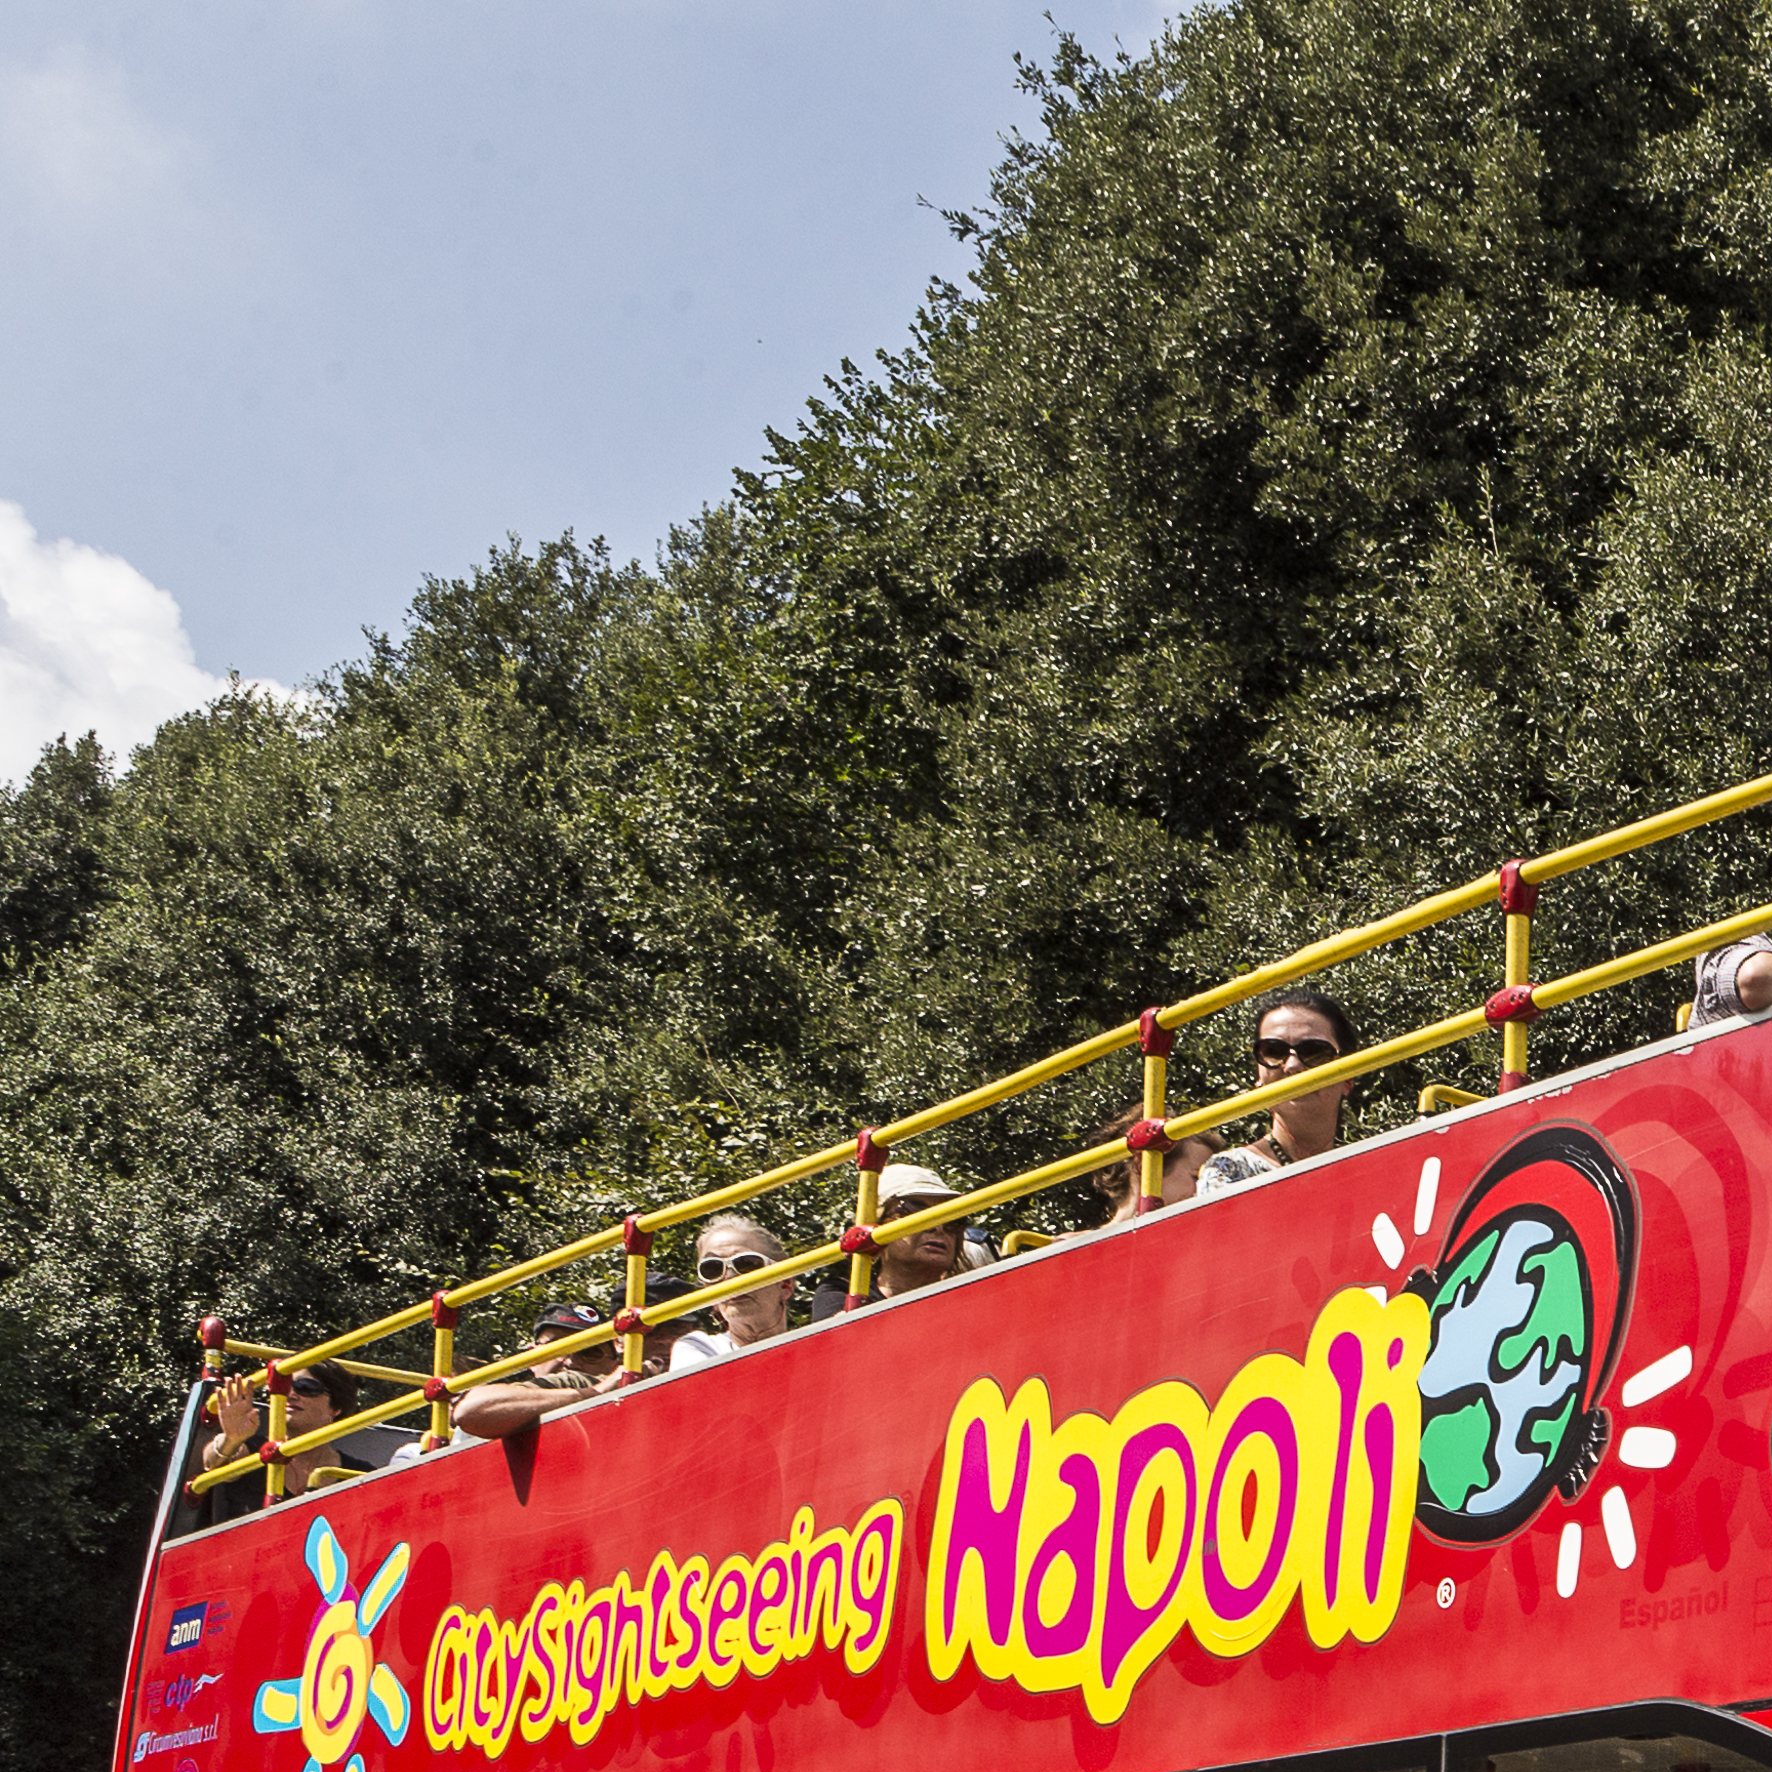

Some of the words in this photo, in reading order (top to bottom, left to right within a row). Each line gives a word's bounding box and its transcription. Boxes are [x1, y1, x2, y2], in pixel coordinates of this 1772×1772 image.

[170, 1618, 202, 1647] anm
[423, 1497, 904, 1760] CitySightseeing
[925, 1285, 1431, 1725] Napoli
